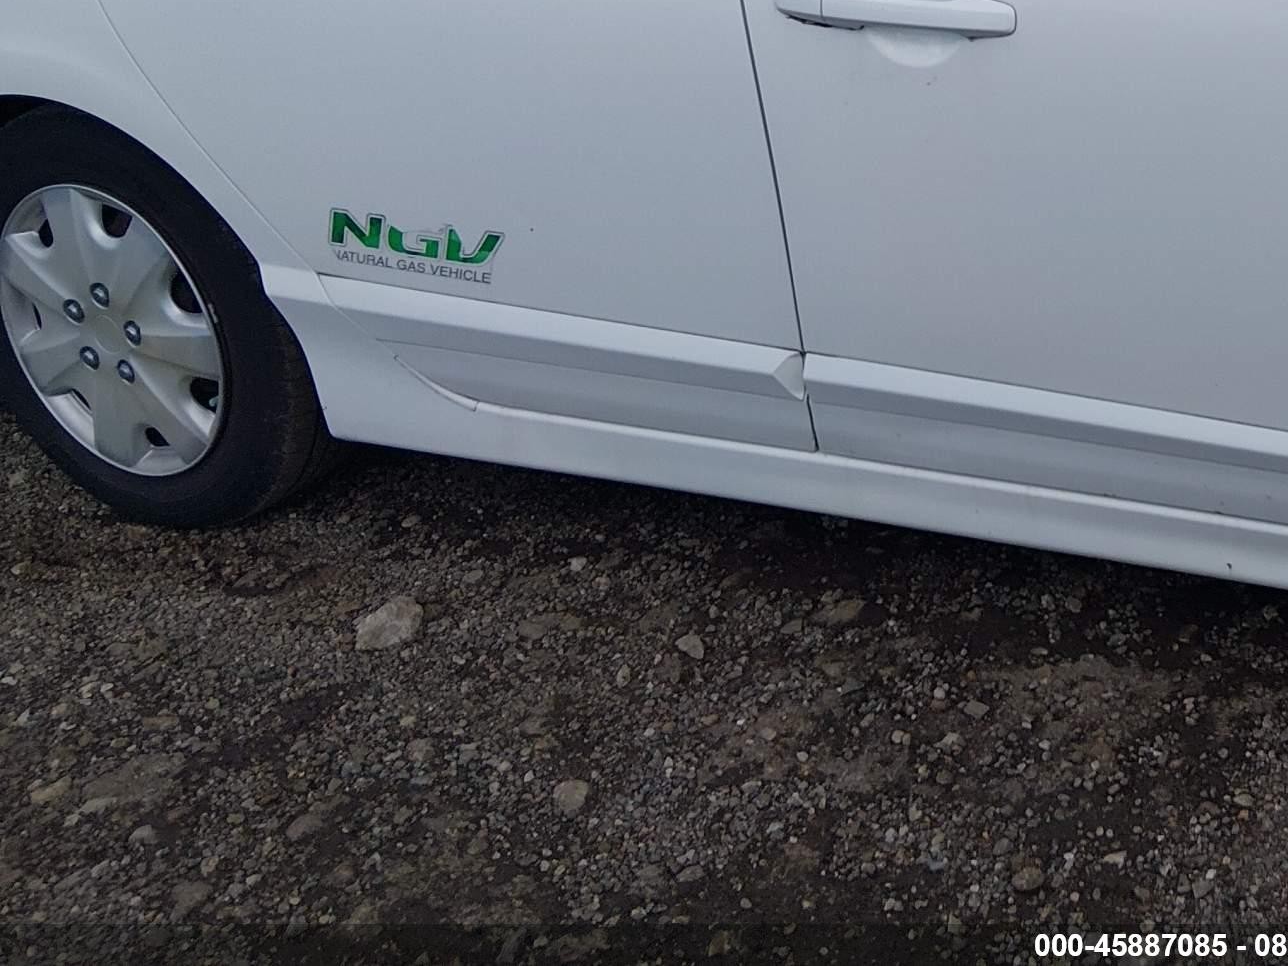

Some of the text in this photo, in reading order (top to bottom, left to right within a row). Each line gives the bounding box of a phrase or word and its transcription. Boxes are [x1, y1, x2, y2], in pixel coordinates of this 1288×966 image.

[329, 208, 504, 266] NGV
[396, 259, 426, 274] GAS
[430, 264, 492, 284] VEHICLE
